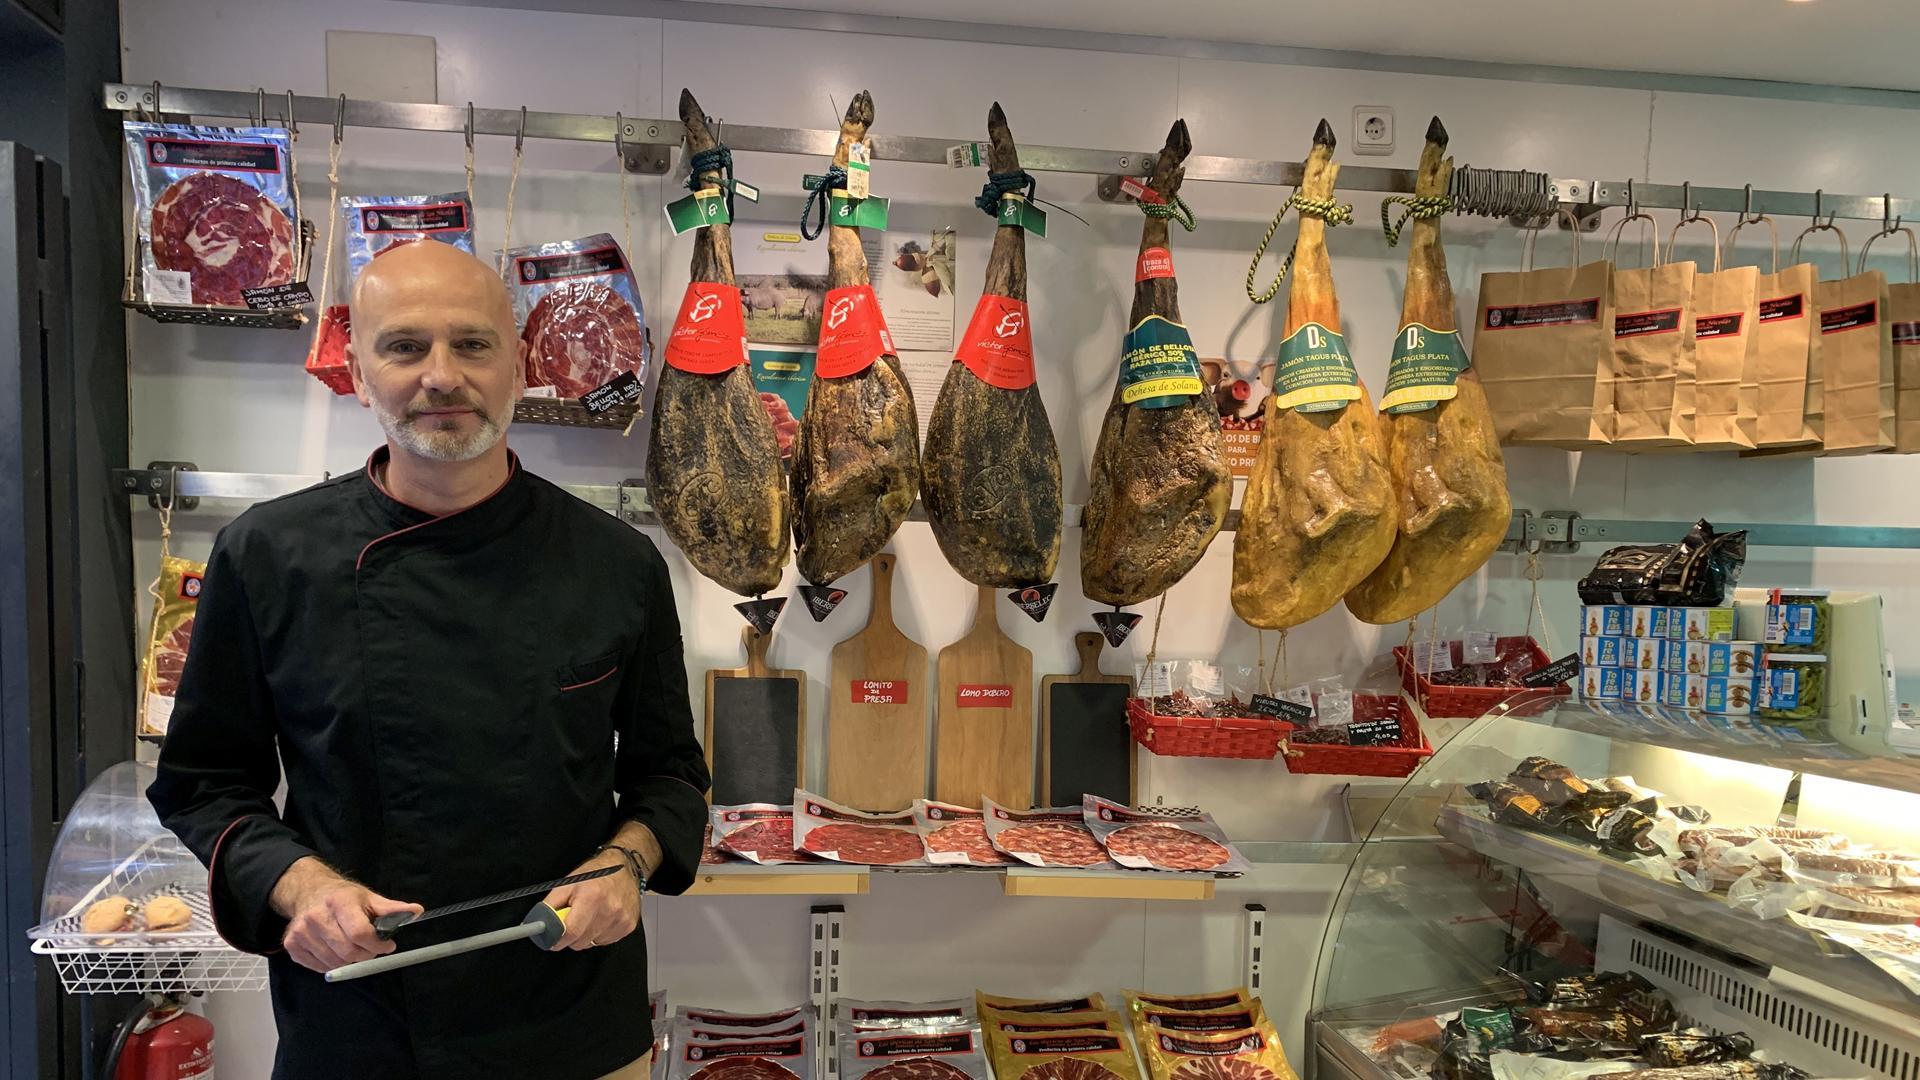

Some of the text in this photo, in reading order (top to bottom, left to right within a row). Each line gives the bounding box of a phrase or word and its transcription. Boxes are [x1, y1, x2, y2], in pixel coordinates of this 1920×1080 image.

[1305, 353, 1331, 362] TAGUS
[1402, 353, 1450, 363] TAGUS PLATA
[1126, 380, 1199, 399] Dehesa de Solana
[1238, 434, 1251, 444] DE
[1227, 446, 1247, 455] PARA
[863, 681, 893, 689] LOMITO
[960, 688, 981, 697] LOMO
[864, 695, 893, 704] PRESA
